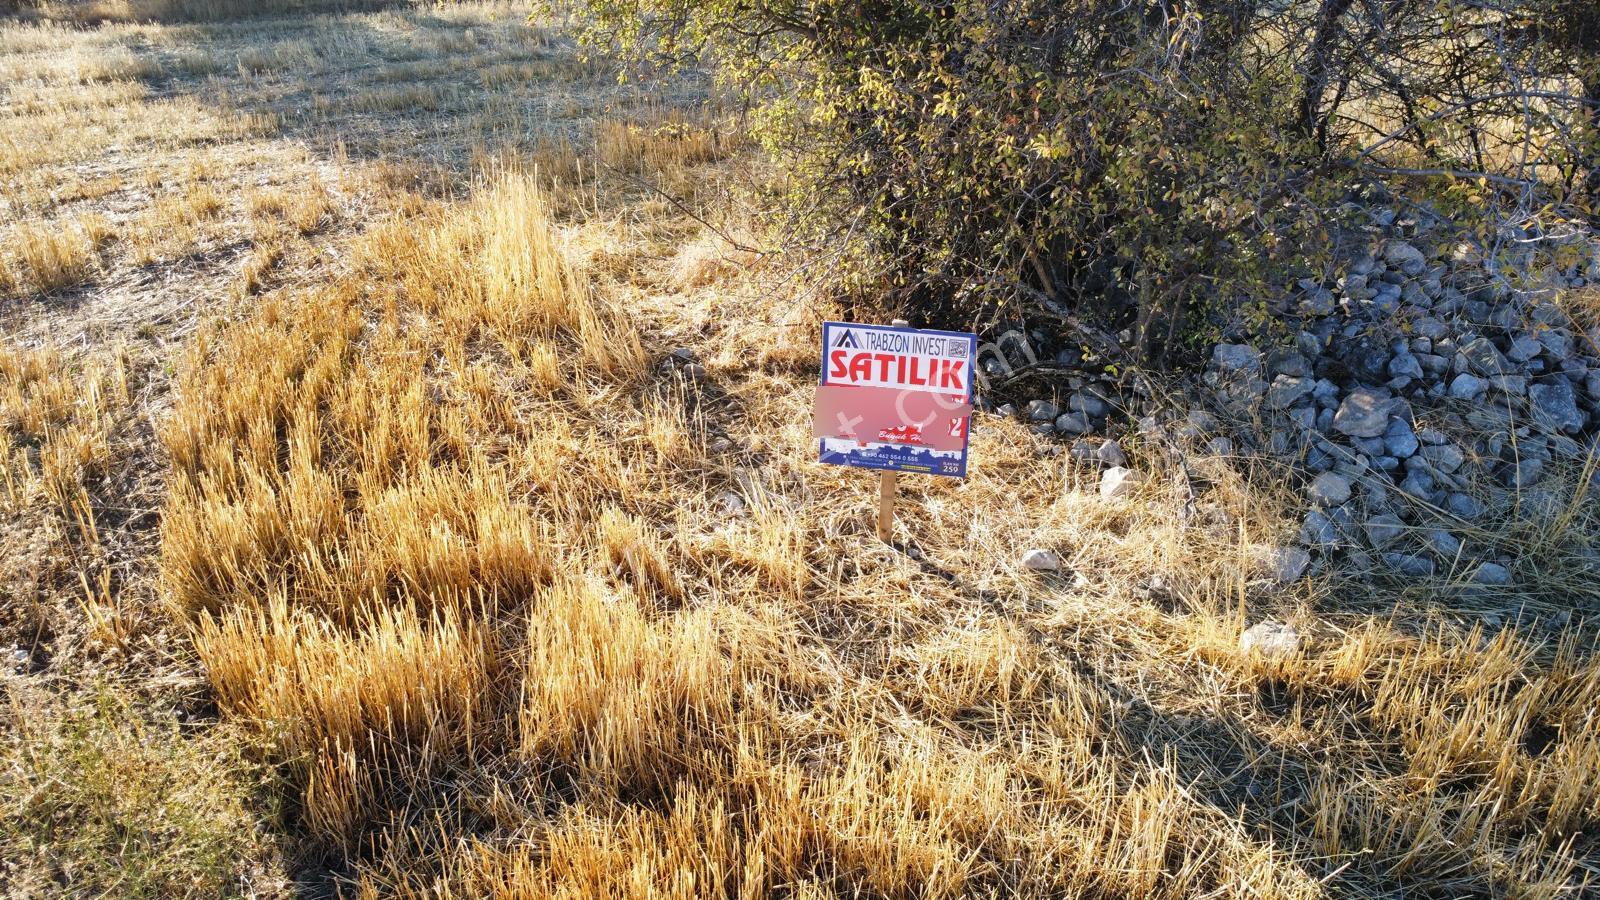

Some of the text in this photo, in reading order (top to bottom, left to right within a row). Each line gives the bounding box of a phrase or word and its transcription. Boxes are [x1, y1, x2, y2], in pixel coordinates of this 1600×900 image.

[865, 331, 947, 357] TRABZON INVEST
[830, 350, 965, 389] SATILIK
[943, 465, 959, 473] 259
